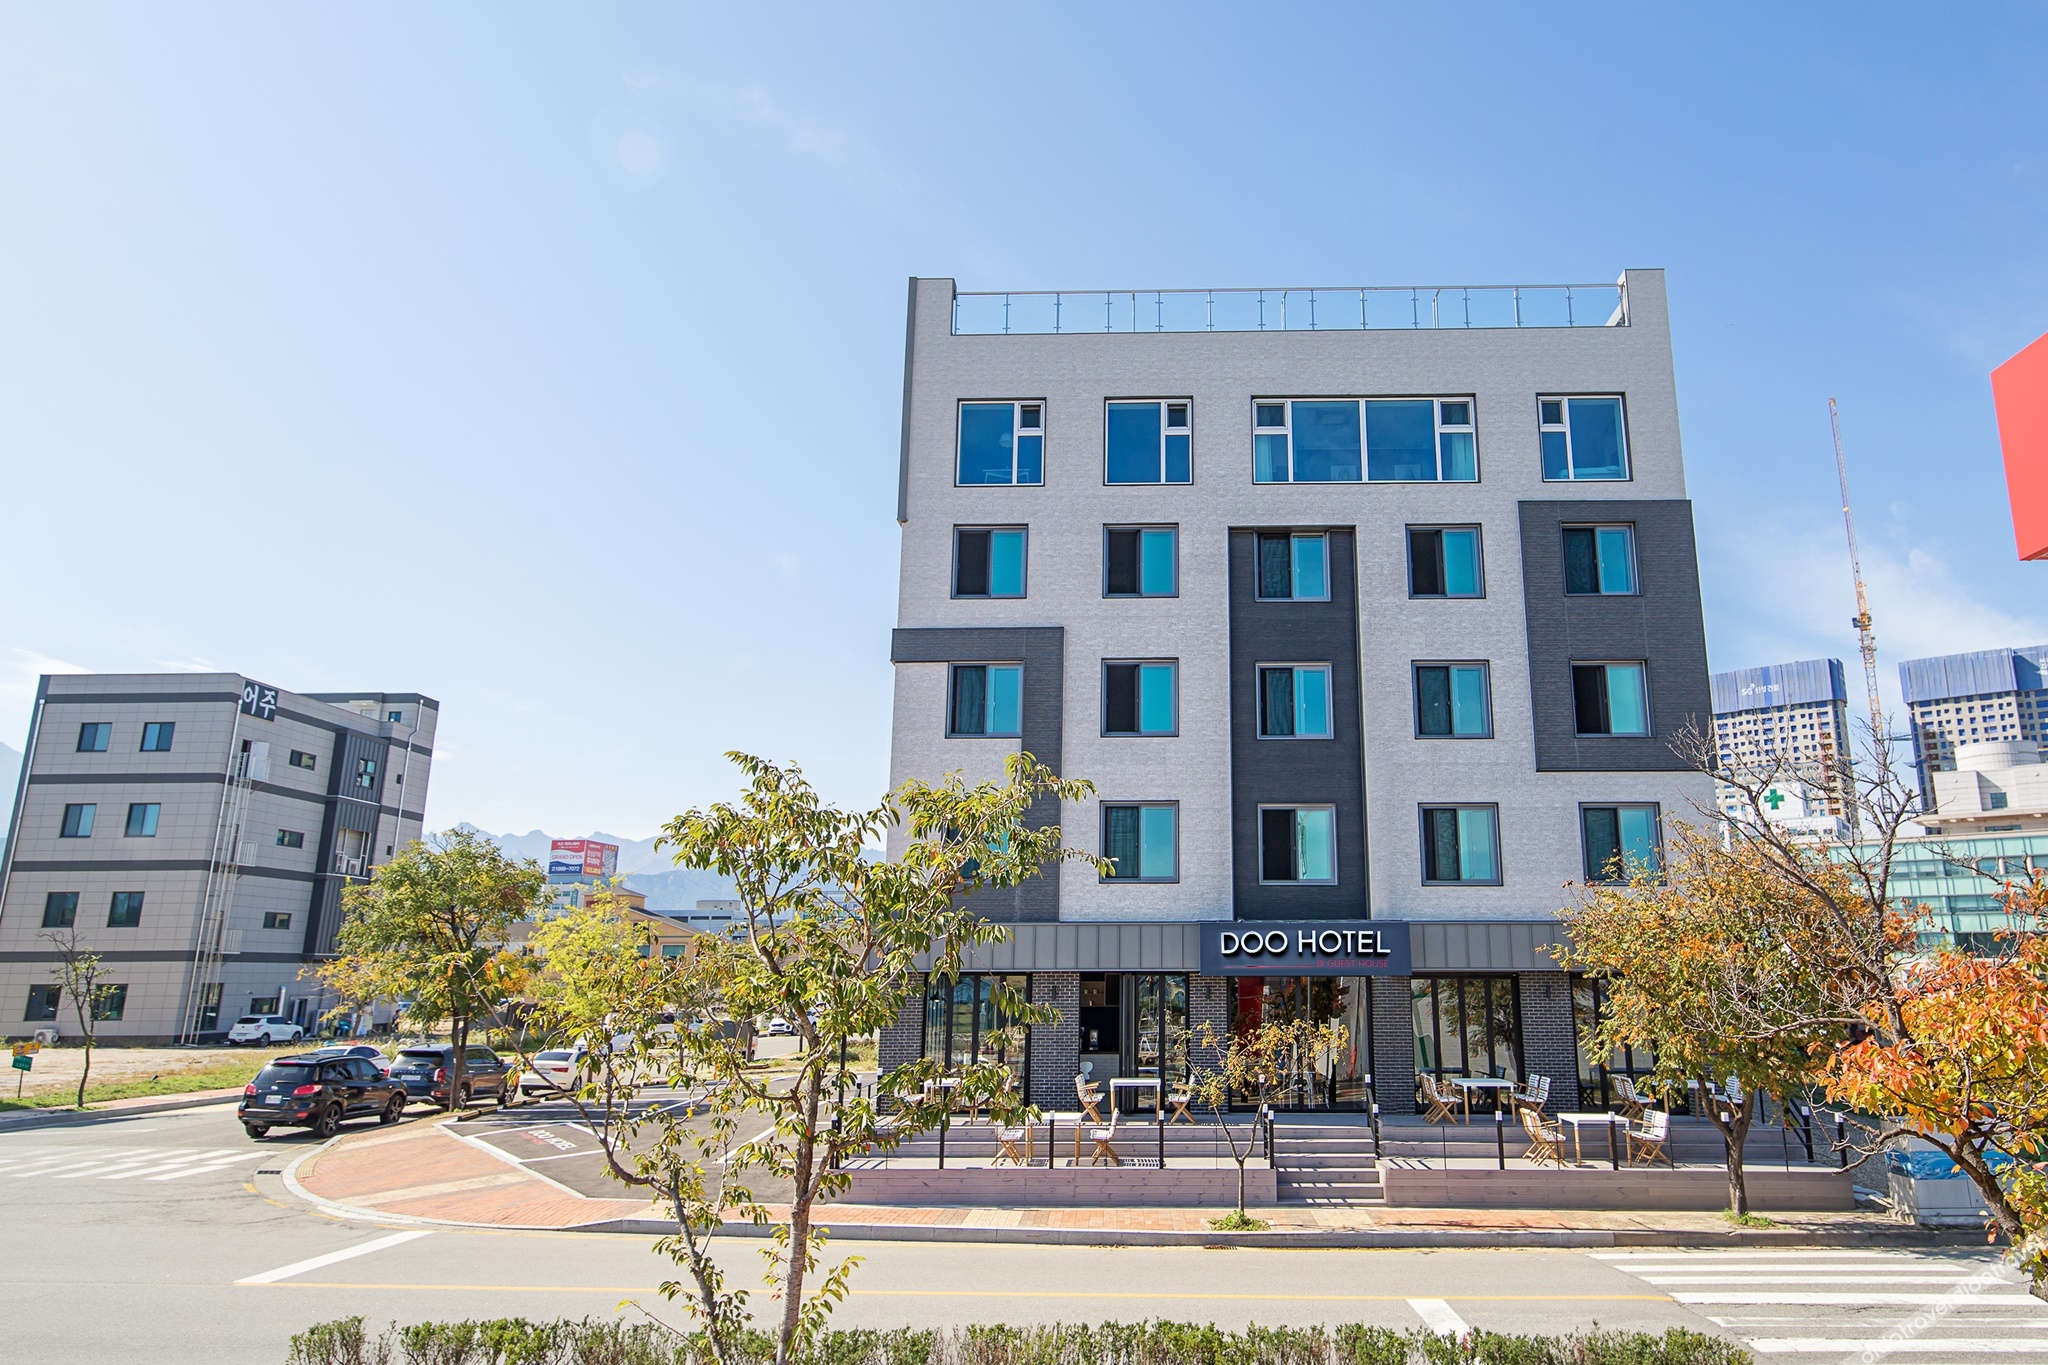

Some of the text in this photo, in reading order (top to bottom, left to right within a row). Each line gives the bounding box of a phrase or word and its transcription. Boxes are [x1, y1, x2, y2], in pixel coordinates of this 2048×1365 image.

[243, 684, 277, 719] 어주
[1220, 929, 1392, 954] DOO HOTEL
[1316, 959, 1389, 968] & GUEST HOUSE
